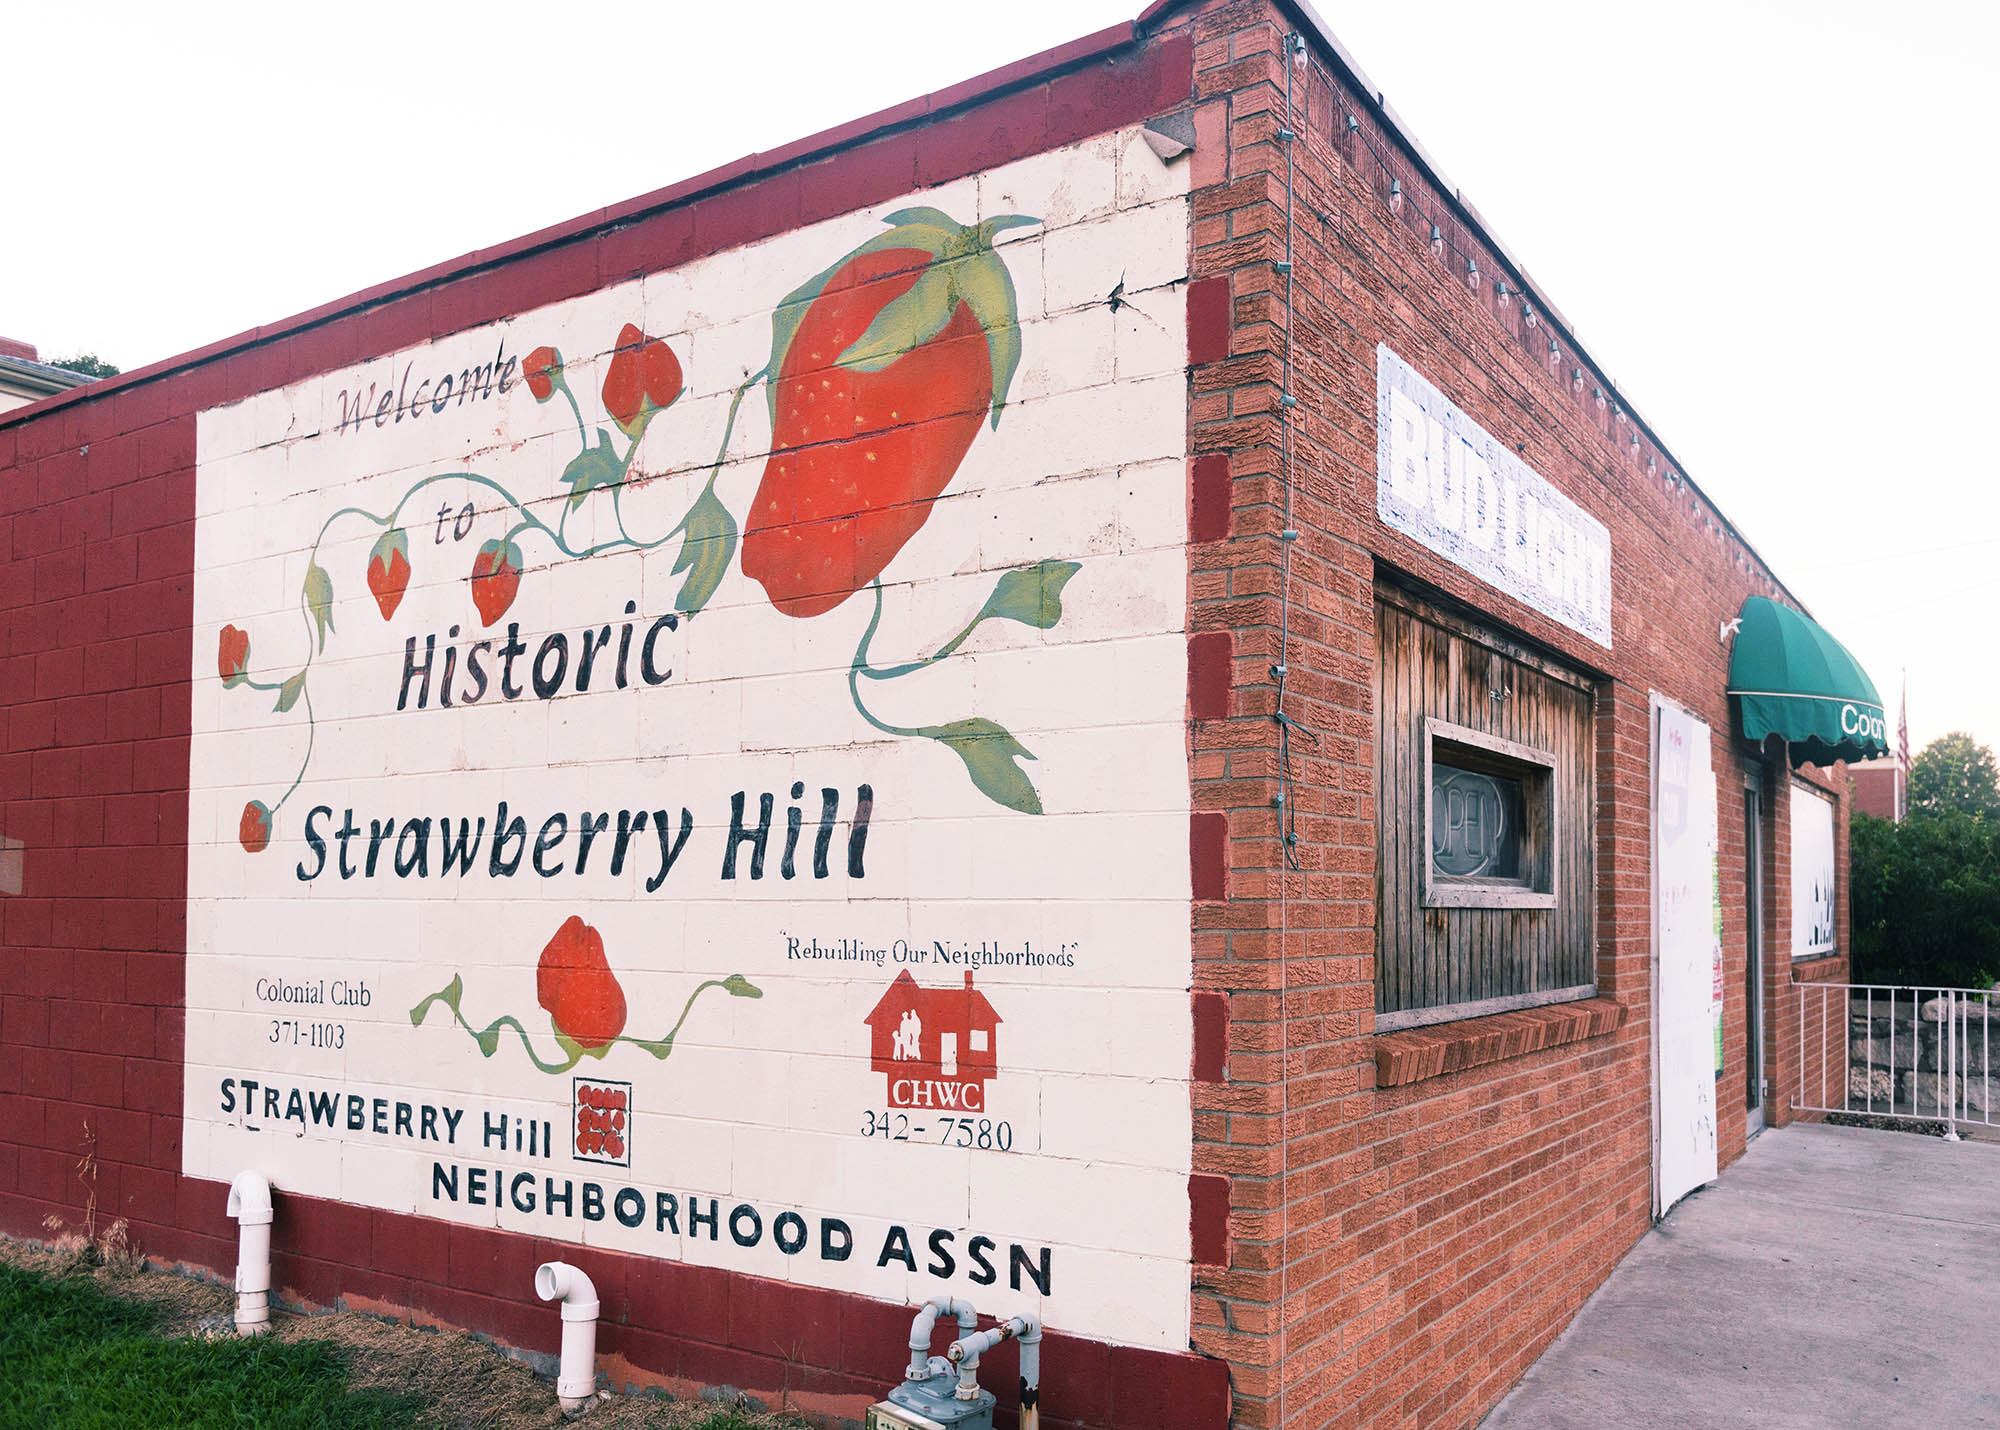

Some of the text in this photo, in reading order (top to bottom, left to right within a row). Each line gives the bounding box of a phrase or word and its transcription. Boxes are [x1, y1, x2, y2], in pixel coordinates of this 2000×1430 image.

[337, 354, 517, 436] Welcome
[1389, 386, 1499, 551] BUD
[434, 500, 475, 545] to
[396, 600, 679, 711] Historic
[297, 781, 873, 893] Strawberry Hill
[1432, 784, 1498, 858] OPEN
[893, 940, 928, 964] Our
[256, 978, 371, 1008] Colonial Club
[268, 1019, 345, 1050] 371-1103
[221, 1078, 551, 1159] STRAWBERRY Hill
[892, 1080, 981, 1110] CHWC
[433, 1162, 1052, 1297] NEIGHBORHOOD ASSN
